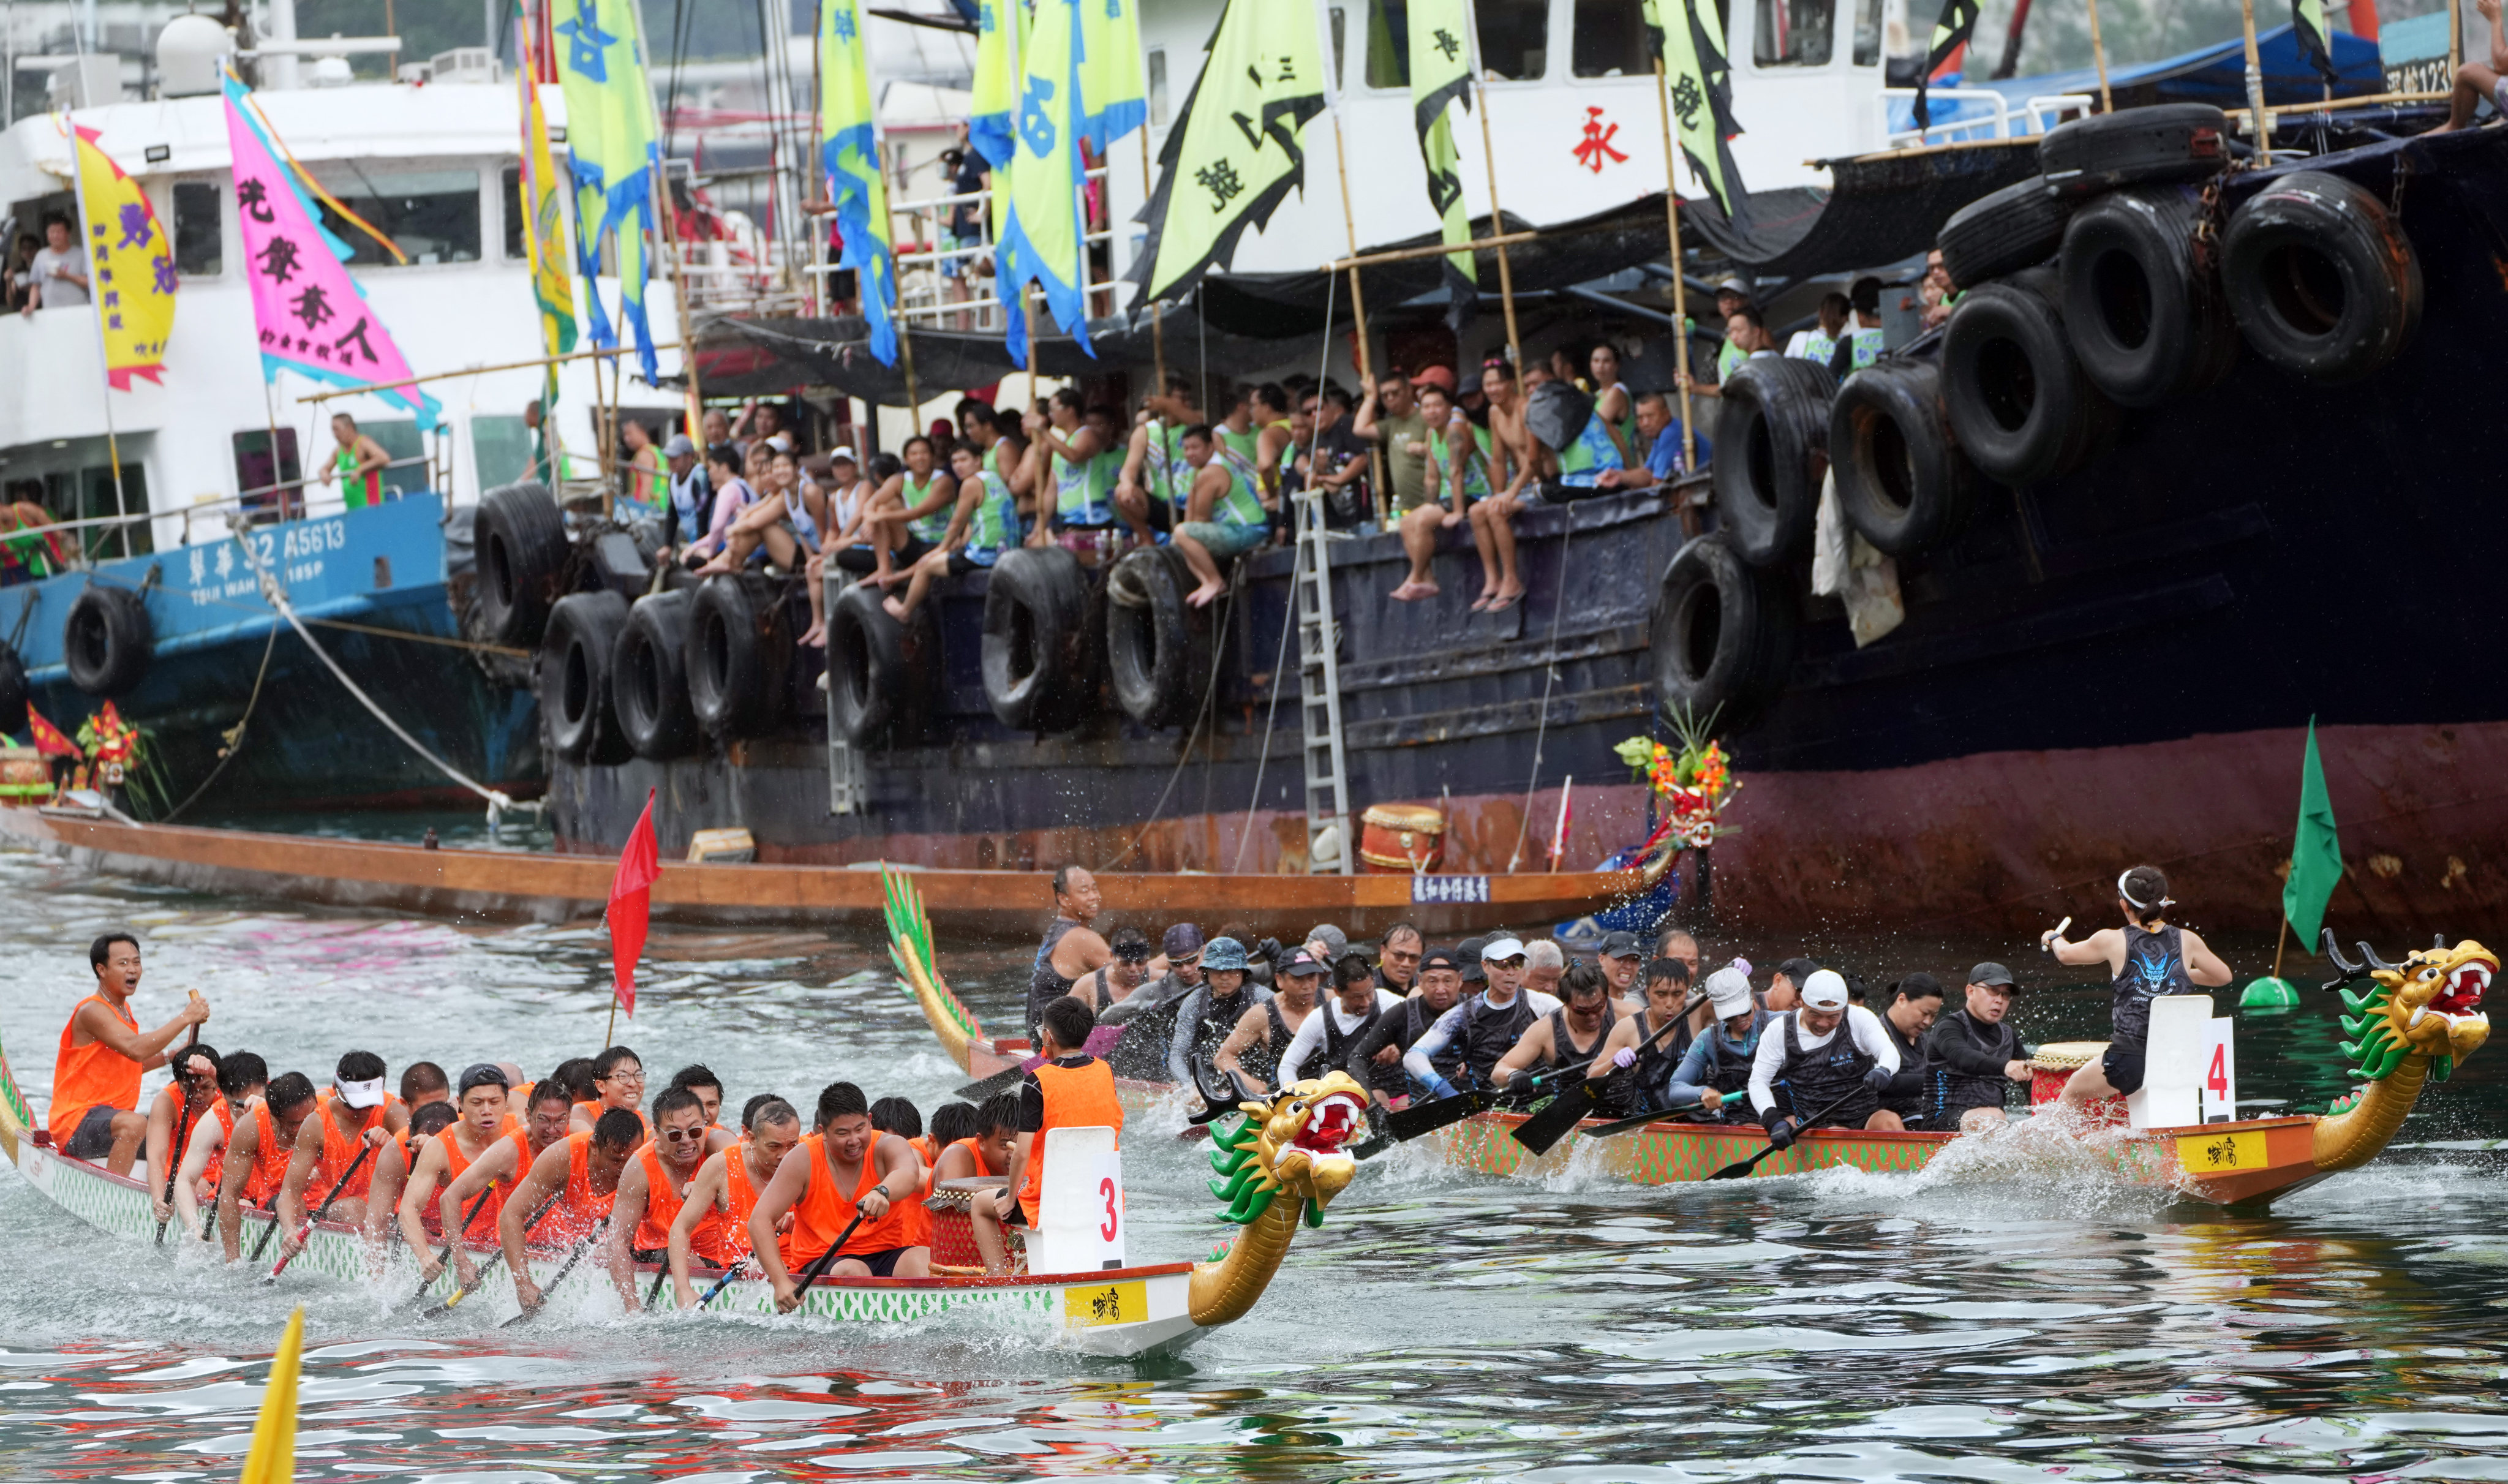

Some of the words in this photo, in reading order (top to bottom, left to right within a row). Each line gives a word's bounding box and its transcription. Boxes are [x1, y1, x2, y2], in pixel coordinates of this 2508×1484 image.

[1572, 106, 1630, 175] 永
[284, 519, 346, 560] A5613
[224, 577, 257, 598] WAH
[2161, 987, 2174, 997] CLUB
[2207, 1043, 2227, 1101] 4
[1099, 1177, 1117, 1243] 3
